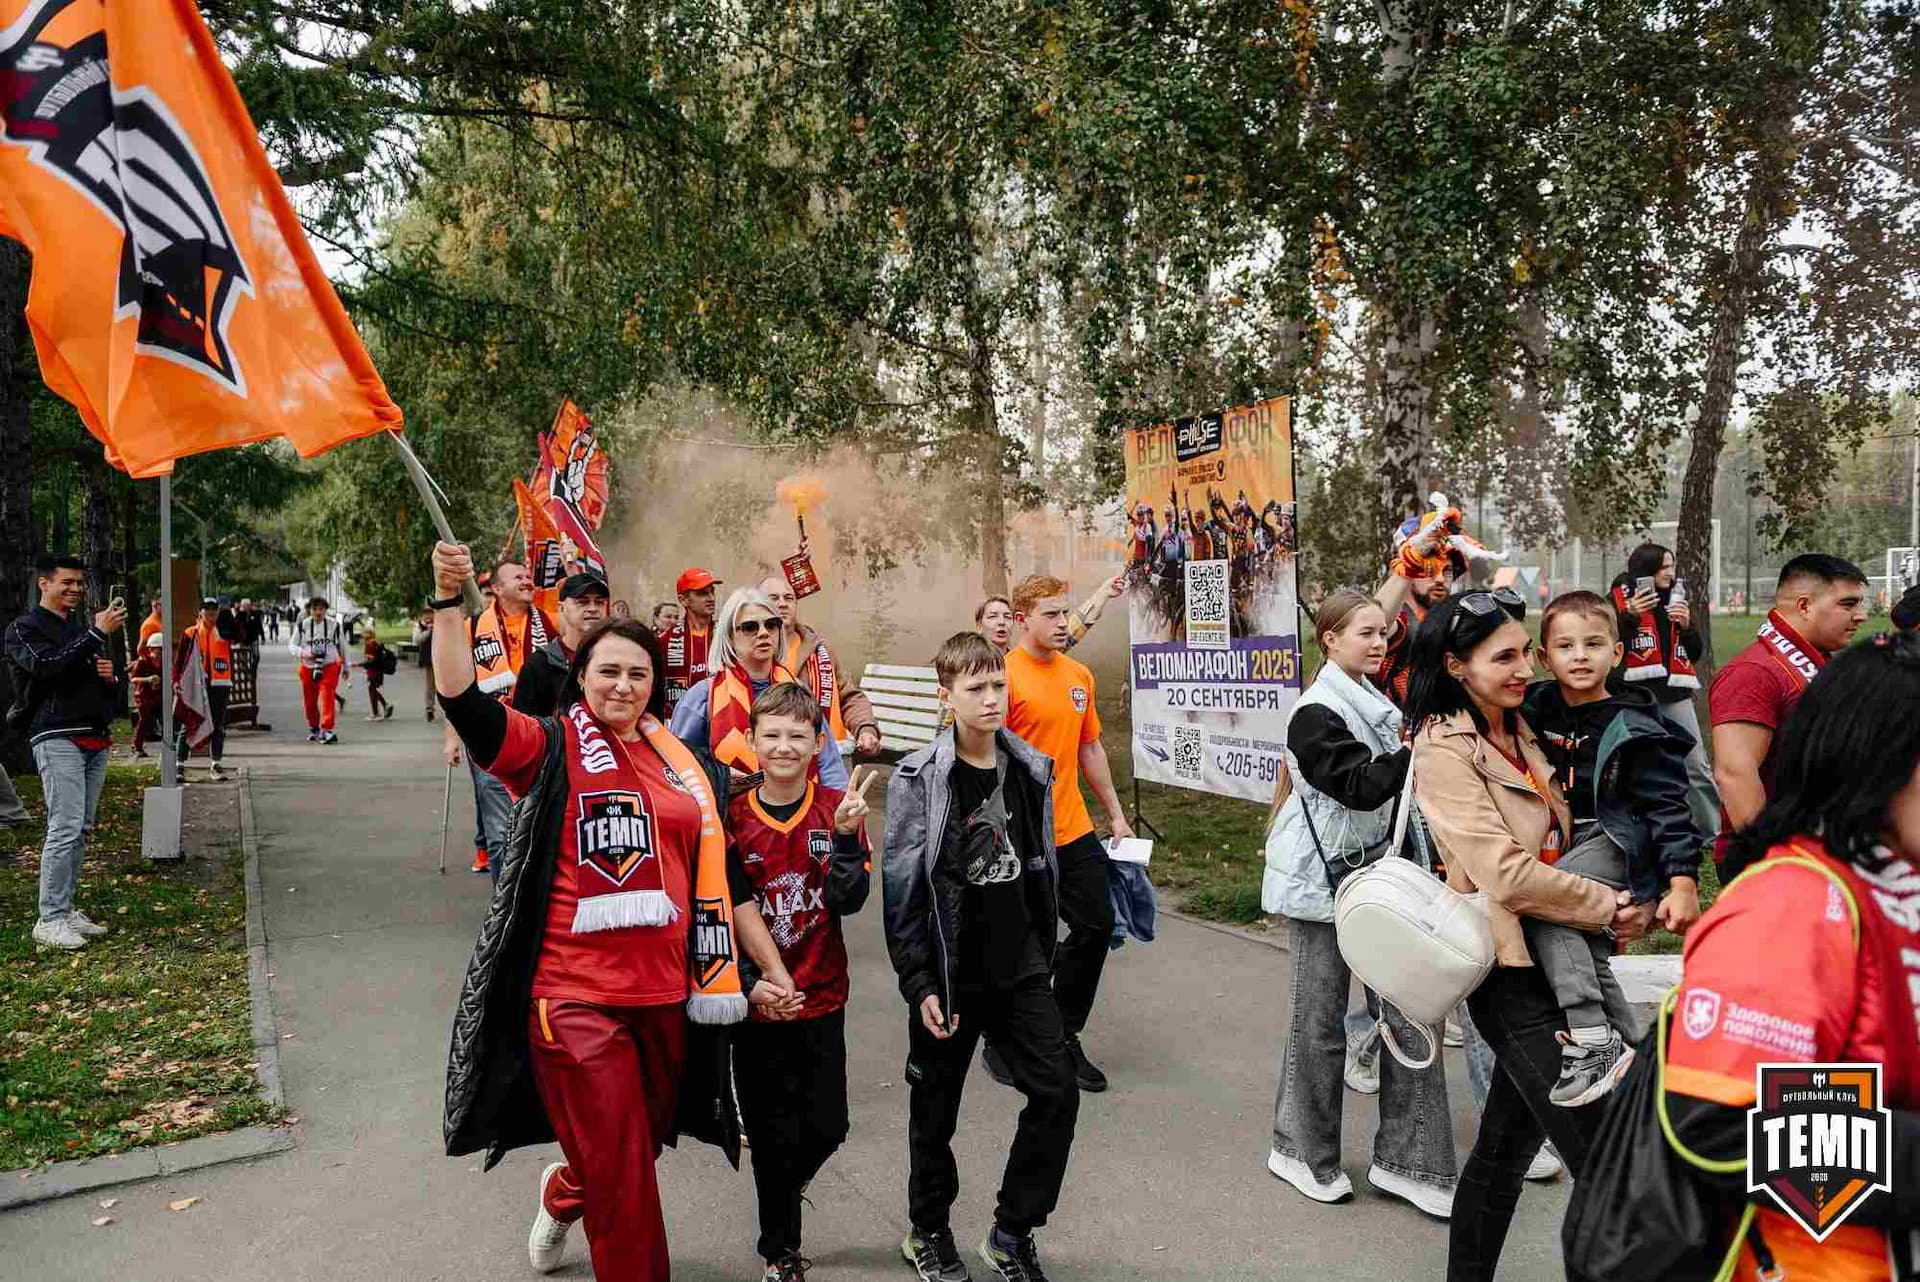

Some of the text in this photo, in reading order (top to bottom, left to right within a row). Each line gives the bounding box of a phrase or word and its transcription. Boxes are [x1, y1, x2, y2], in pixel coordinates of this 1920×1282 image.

[1138, 648, 1294, 681] ВЕЛОМАРАФОН 2025
[1167, 687, 1279, 711] 20 СЕНТЯБРЯ
[583, 816, 647, 854] ТЕМП
[752, 886, 825, 917] ALAX
[696, 924, 730, 956] МП
